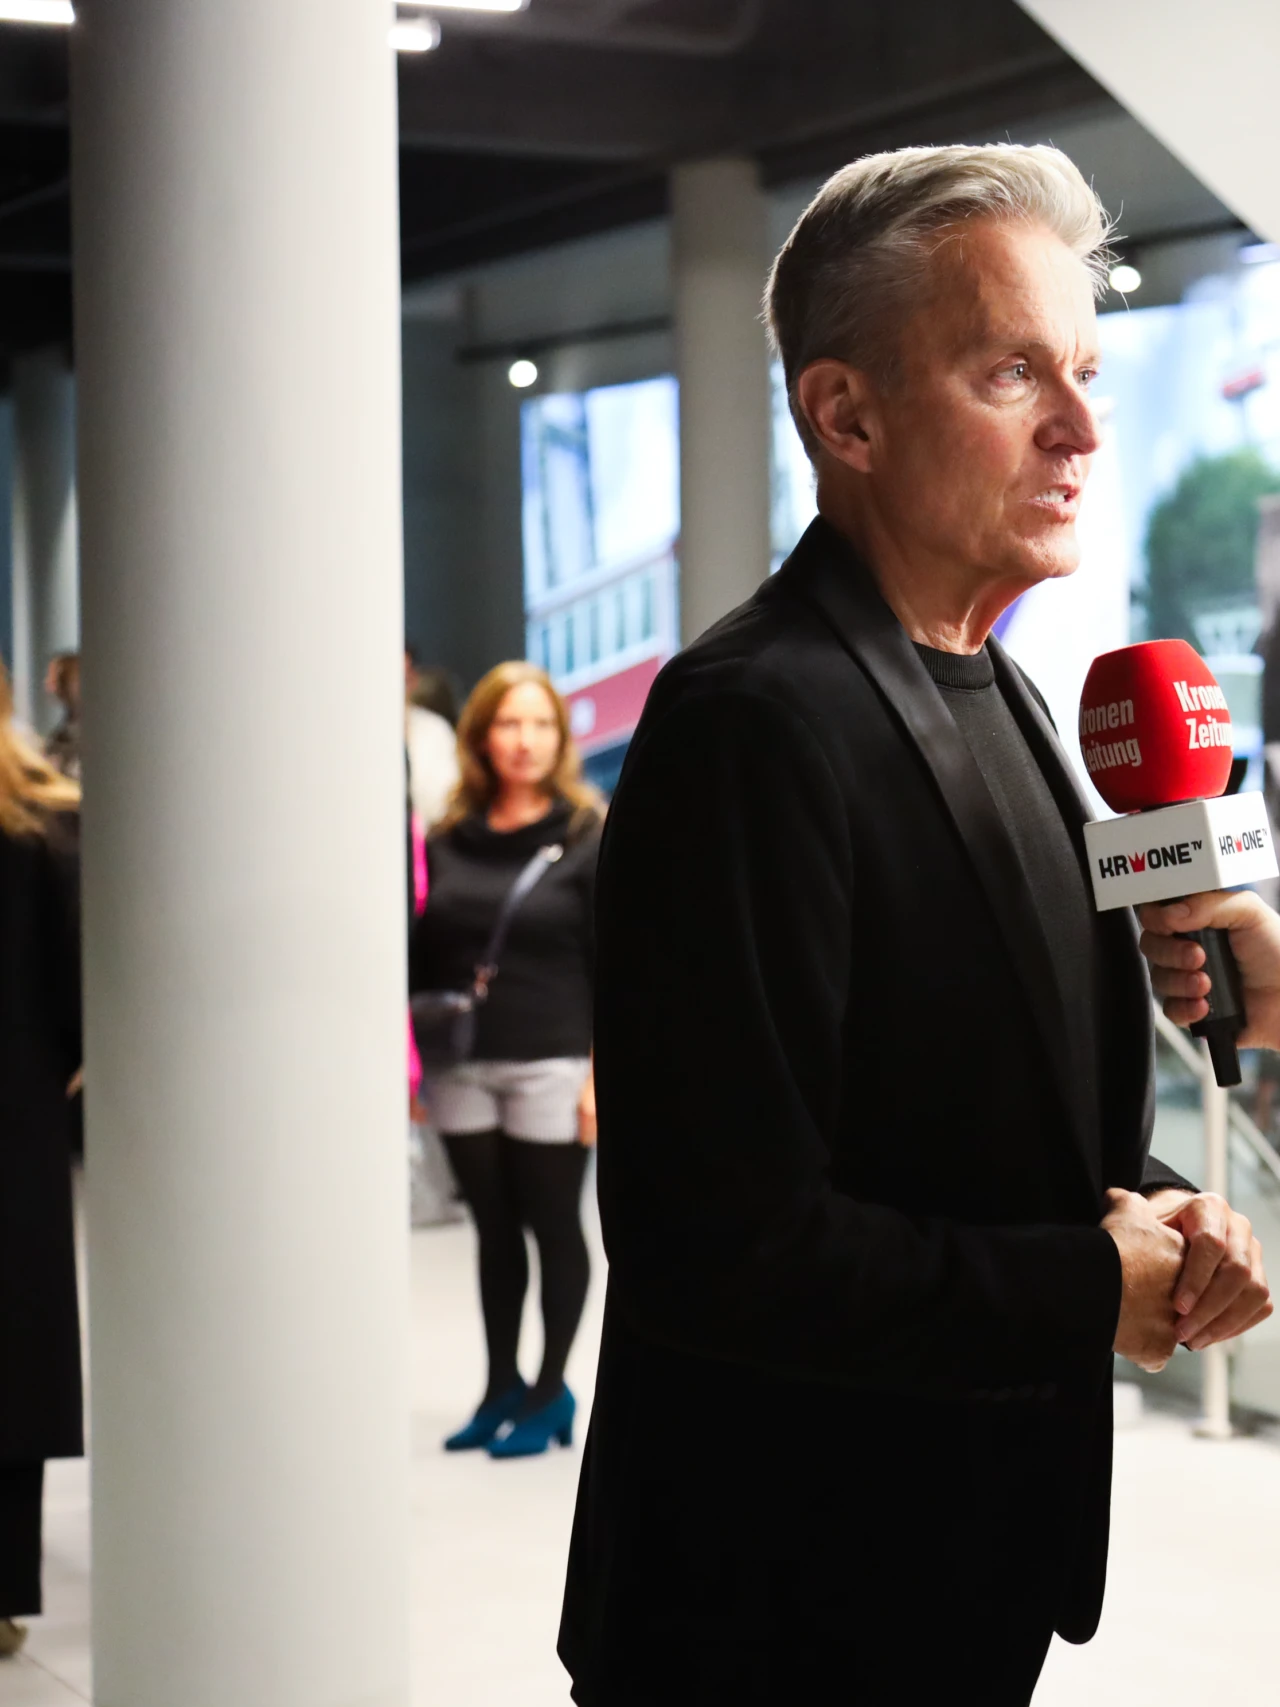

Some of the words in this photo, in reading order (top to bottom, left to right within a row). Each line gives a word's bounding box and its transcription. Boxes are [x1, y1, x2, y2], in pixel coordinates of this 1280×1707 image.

[1173, 681, 1228, 712] Krone
[1185, 714, 1233, 752] Zeitun
[1191, 840, 1202, 850] TV
